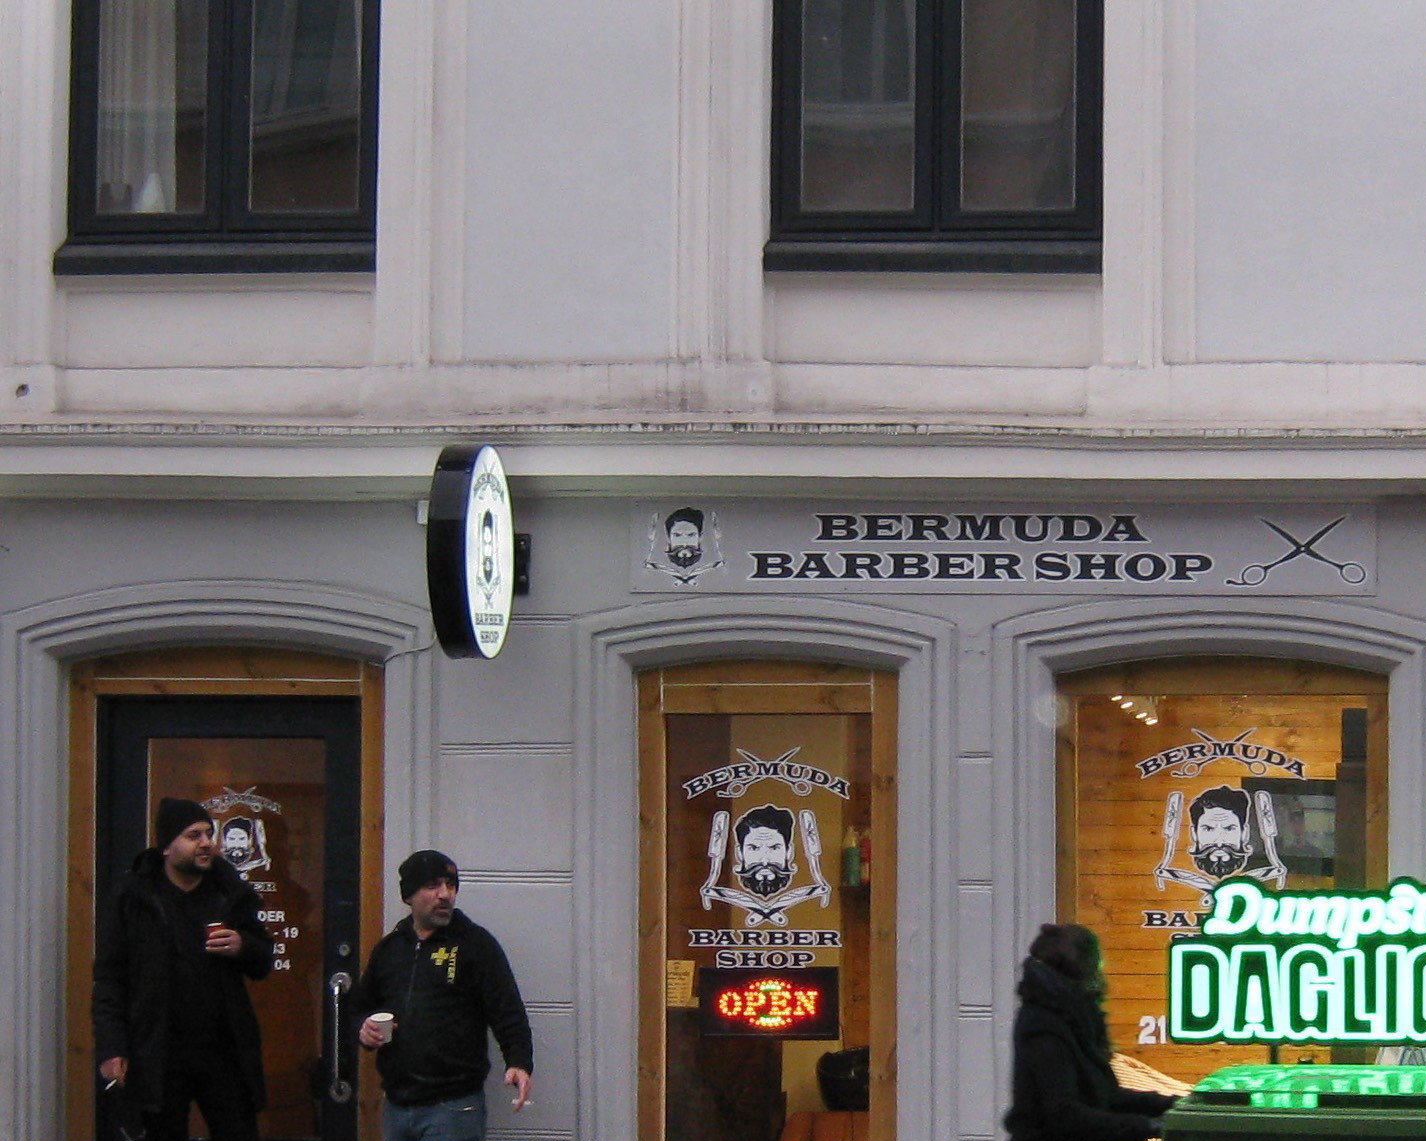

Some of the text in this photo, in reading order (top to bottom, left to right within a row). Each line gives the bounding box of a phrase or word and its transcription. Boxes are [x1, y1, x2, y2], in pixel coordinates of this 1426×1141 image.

[812, 513, 1152, 543] BERMUDA
[747, 551, 1215, 582] BARBER SHOP
[1135, 740, 1307, 781] BERMUDA
[683, 760, 850, 800] BERMUDA
[688, 929, 842, 947] BARBER
[716, 951, 815, 969] SHOP
[718, 988, 819, 1017] OPEN
